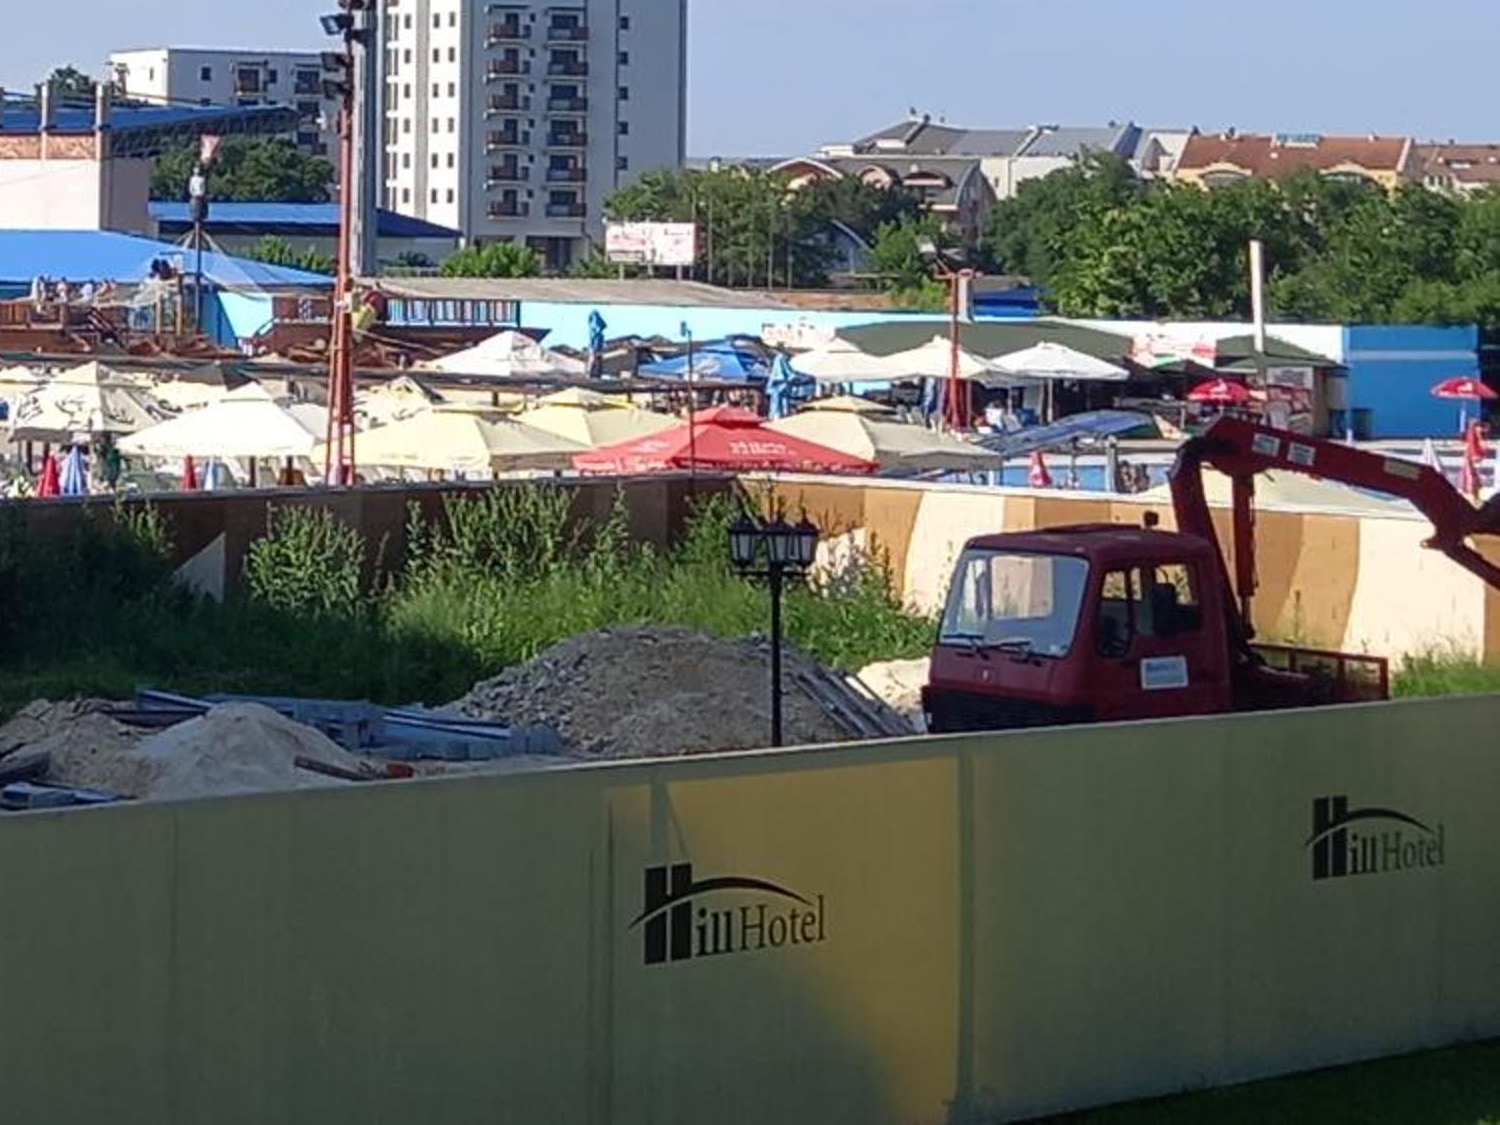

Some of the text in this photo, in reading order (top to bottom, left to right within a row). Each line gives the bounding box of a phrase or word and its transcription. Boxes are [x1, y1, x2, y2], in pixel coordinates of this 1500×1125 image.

[1312, 795, 1444, 881] Hill Hotel
[643, 862, 826, 965] Hill Hotel
